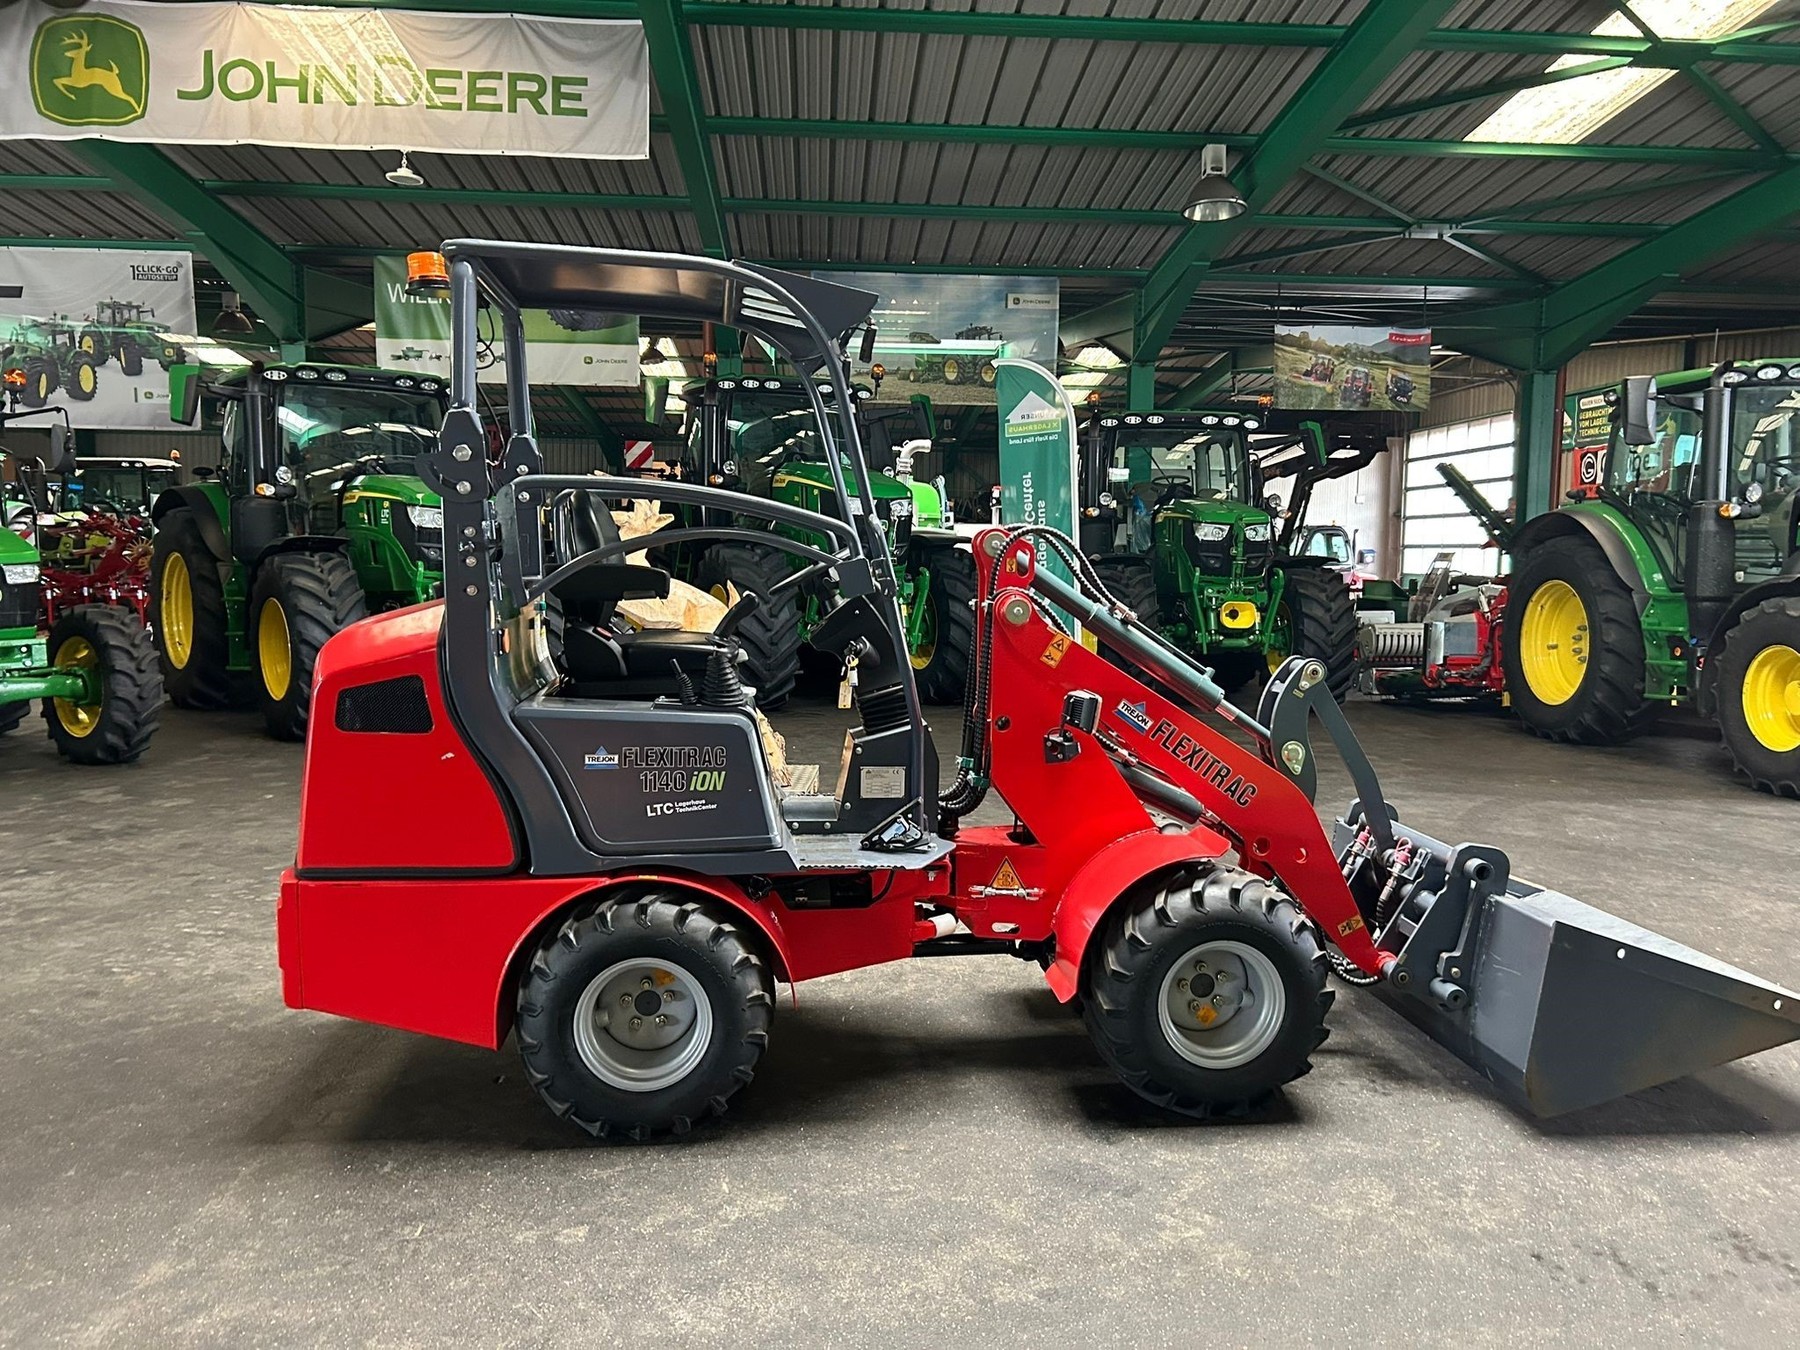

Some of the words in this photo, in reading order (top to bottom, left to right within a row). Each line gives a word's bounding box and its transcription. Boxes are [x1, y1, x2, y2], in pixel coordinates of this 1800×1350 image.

[177, 49, 358, 107] JOHN
[374, 54, 589, 118] DEERE
[1121, 702, 1149, 727] TREJON
[622, 746, 726, 768] FLEXITRAC
[1150, 719, 1257, 808] FLEXITRAC
[690, 771, 726, 791] iON
[646, 803, 674, 816] LTC
[675, 804, 718, 812] TechnikCenter
